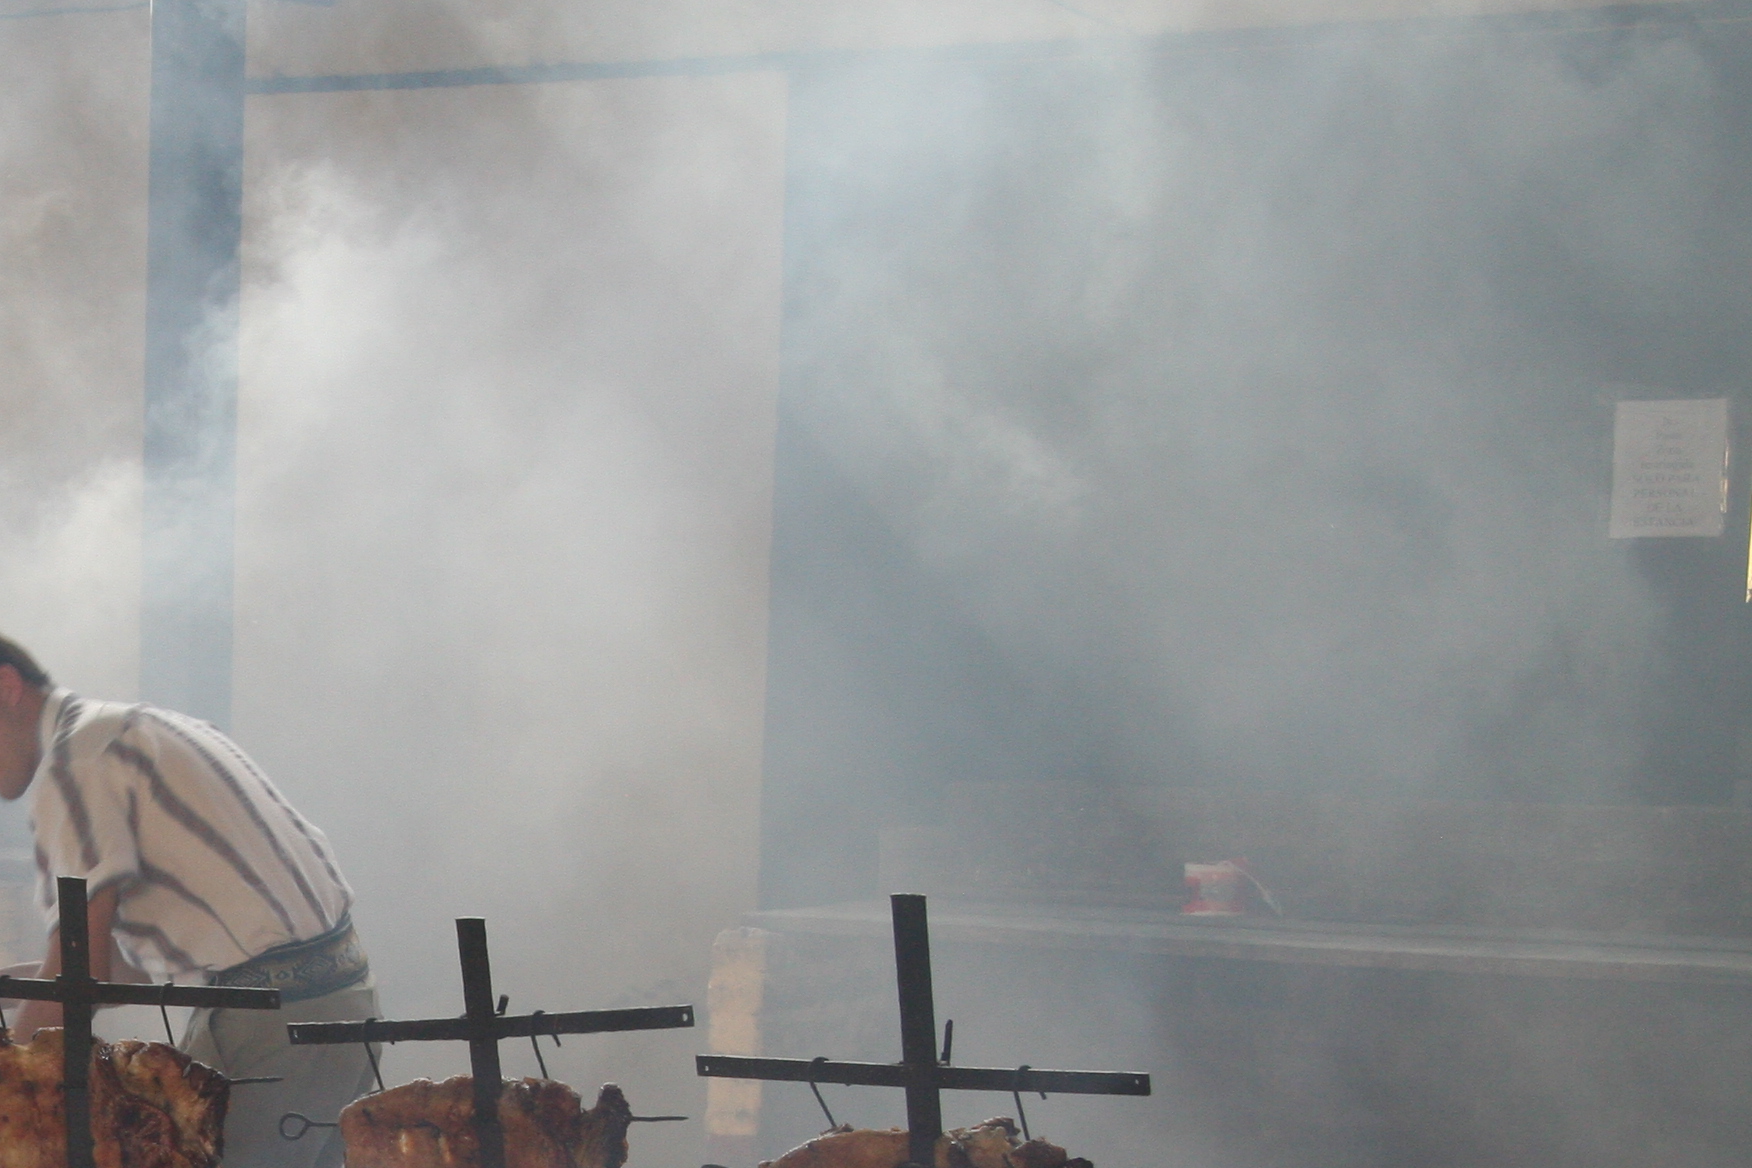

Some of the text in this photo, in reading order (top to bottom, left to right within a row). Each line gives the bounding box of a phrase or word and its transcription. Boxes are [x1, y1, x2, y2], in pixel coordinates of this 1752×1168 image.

[1633, 488, 1695, 498] PERSONAL
[1667, 502, 1682, 512] LA
[1633, 516, 1694, 527] ESTANCIA
